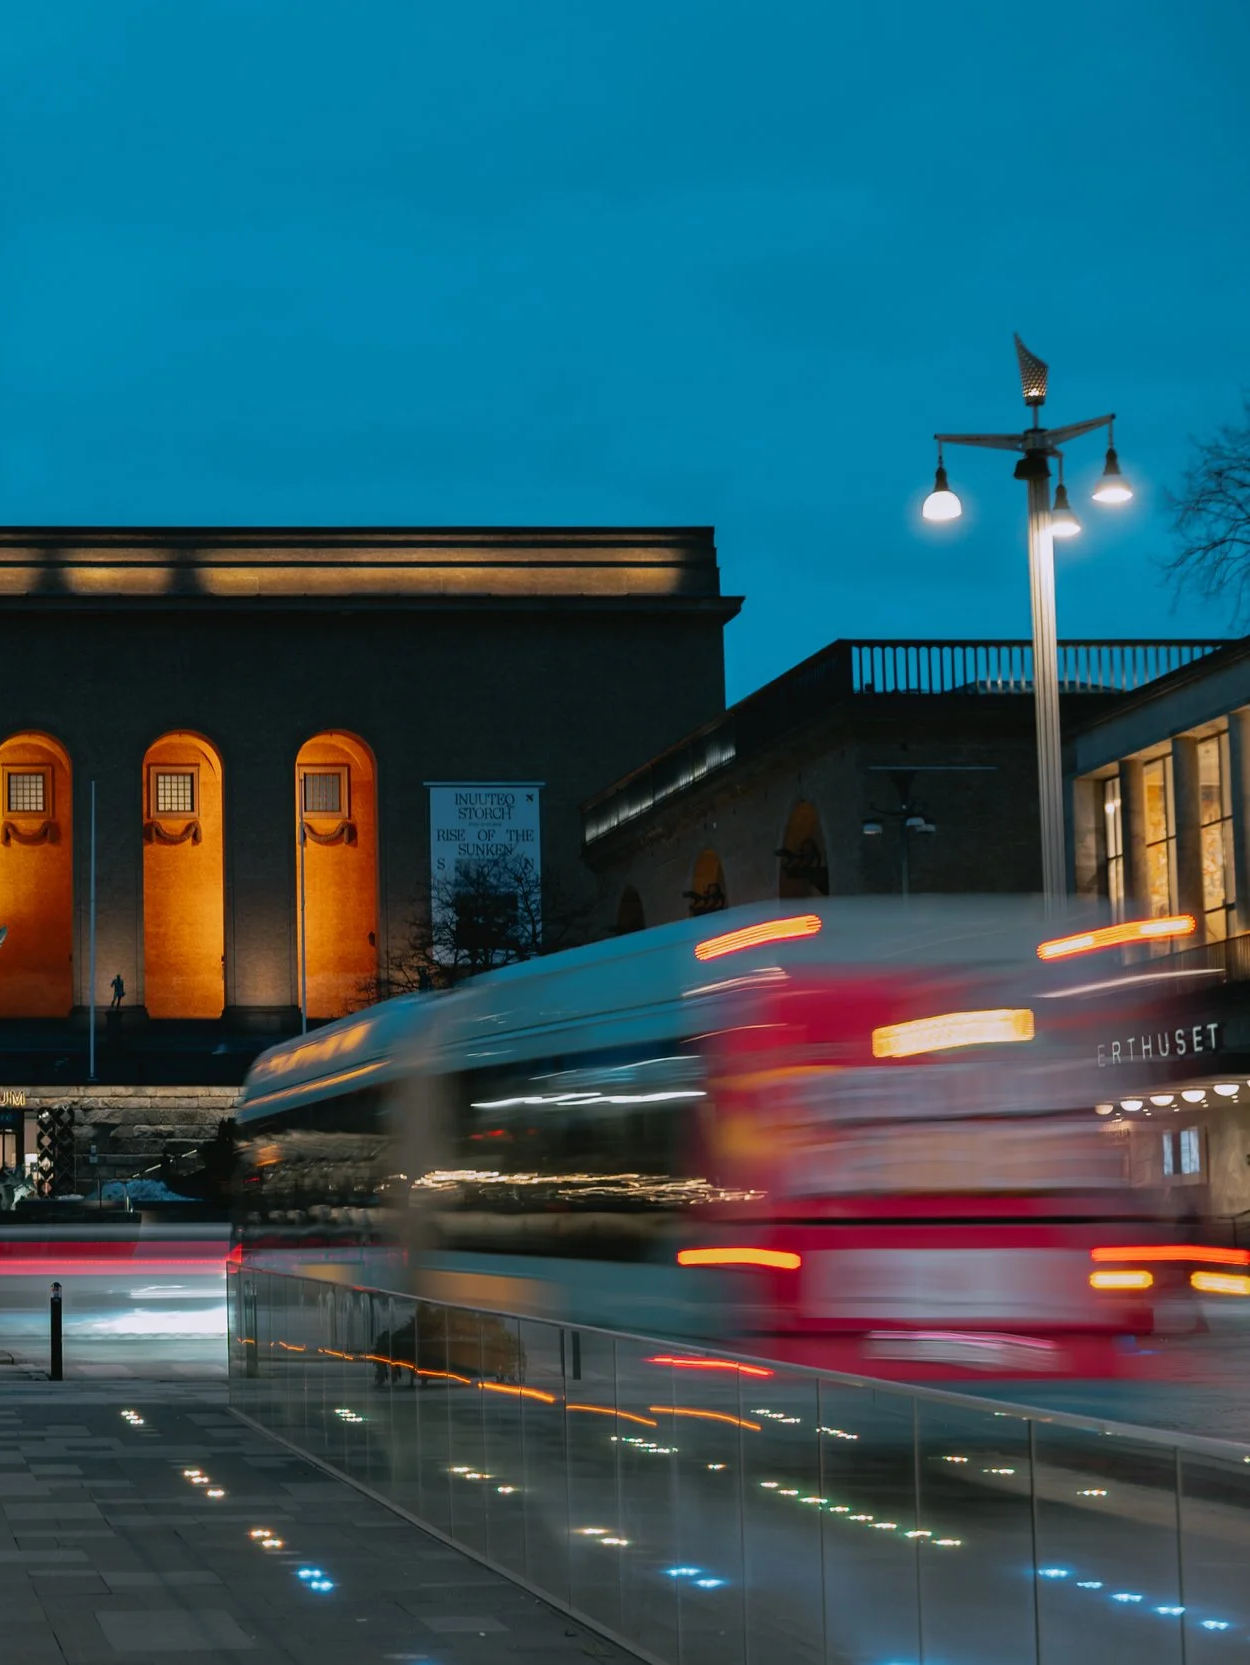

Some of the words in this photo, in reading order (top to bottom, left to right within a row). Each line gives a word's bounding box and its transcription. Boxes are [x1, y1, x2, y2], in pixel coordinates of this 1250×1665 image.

[455, 793, 515, 807] INUUTEQ
[458, 807, 511, 819] STORCH
[437, 829, 465, 841] RISE
[477, 829, 496, 841] OF
[506, 829, 534, 841] THE
[458, 843, 513, 856] SUNKEN
